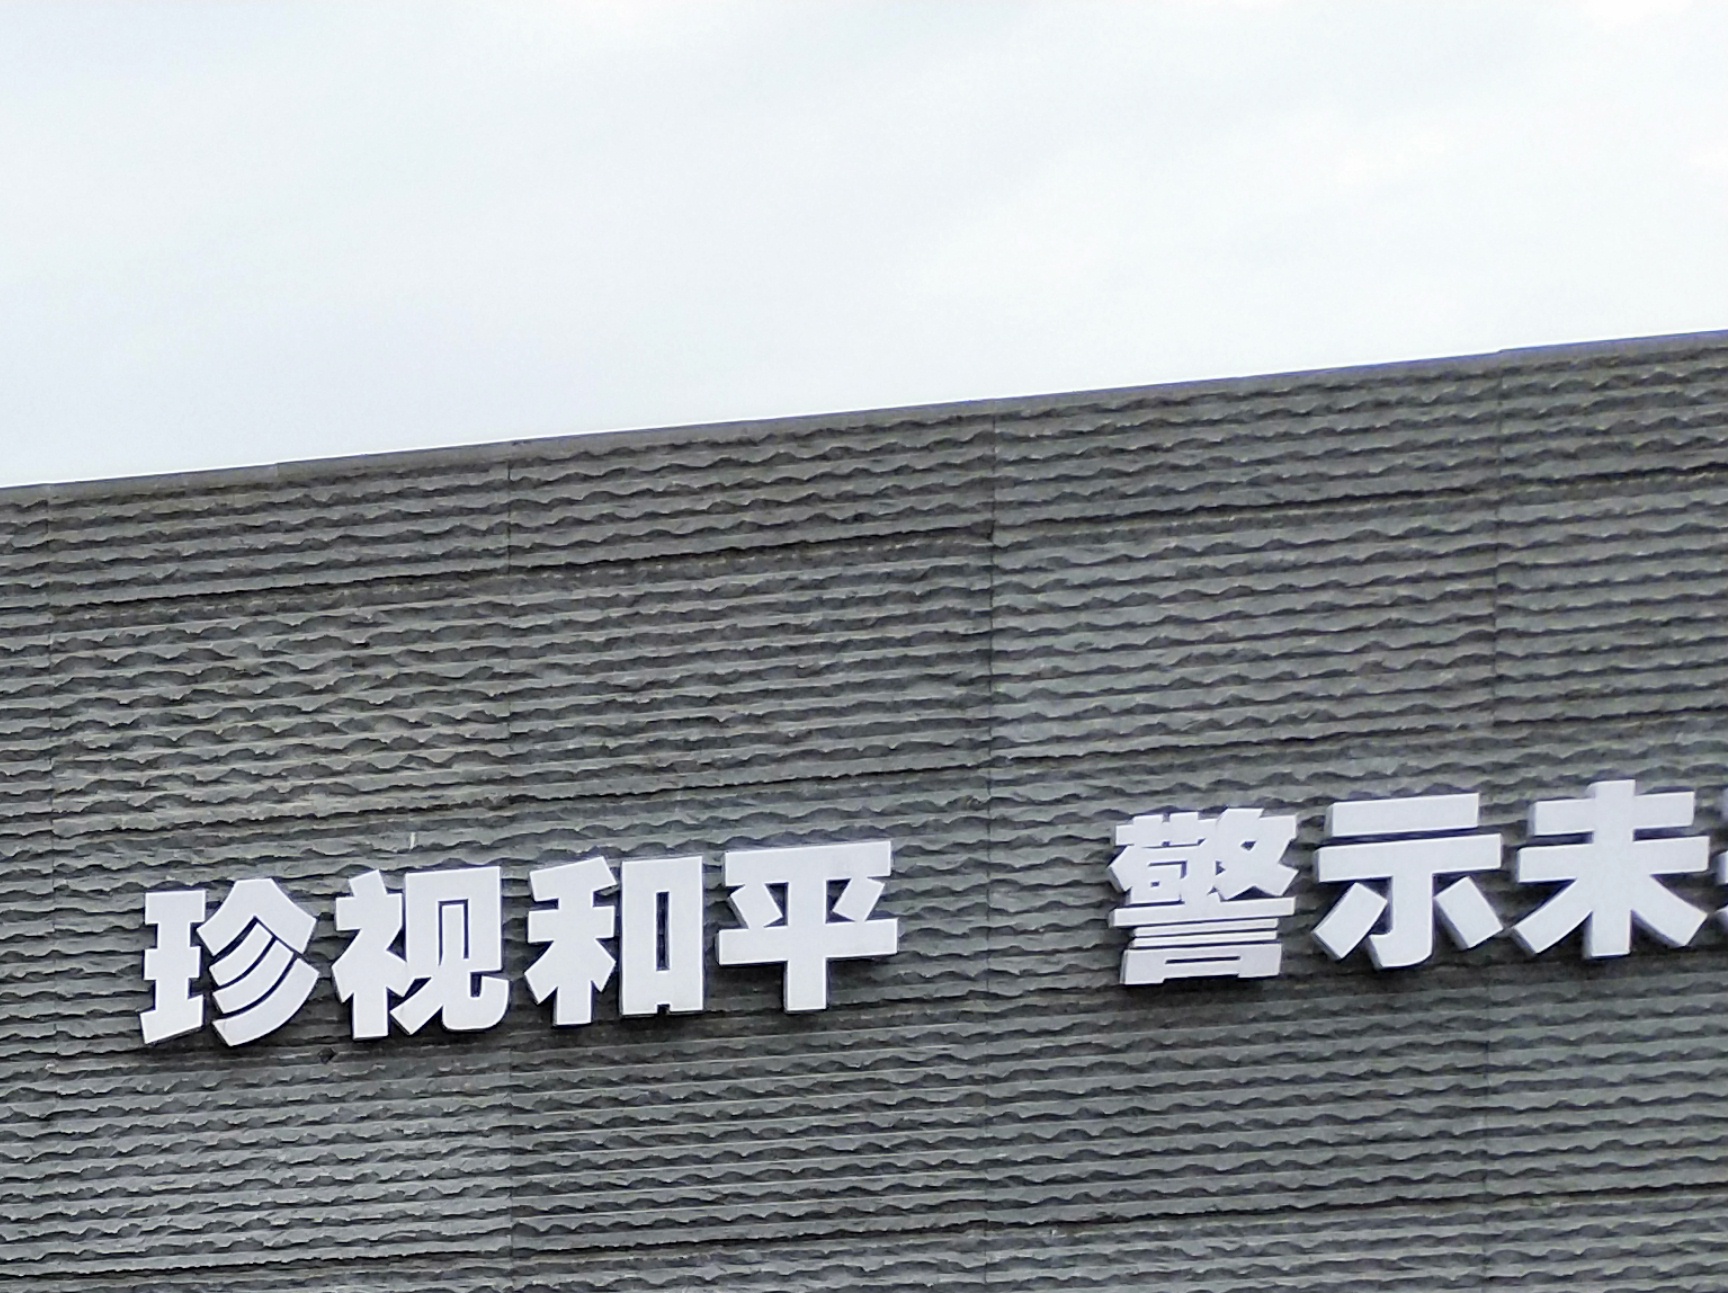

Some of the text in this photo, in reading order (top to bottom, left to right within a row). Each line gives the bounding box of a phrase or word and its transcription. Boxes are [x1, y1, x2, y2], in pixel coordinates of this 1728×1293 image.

[139, 840, 899, 1047] 珍视和平
[1108, 778, 1728, 985] 警示未
